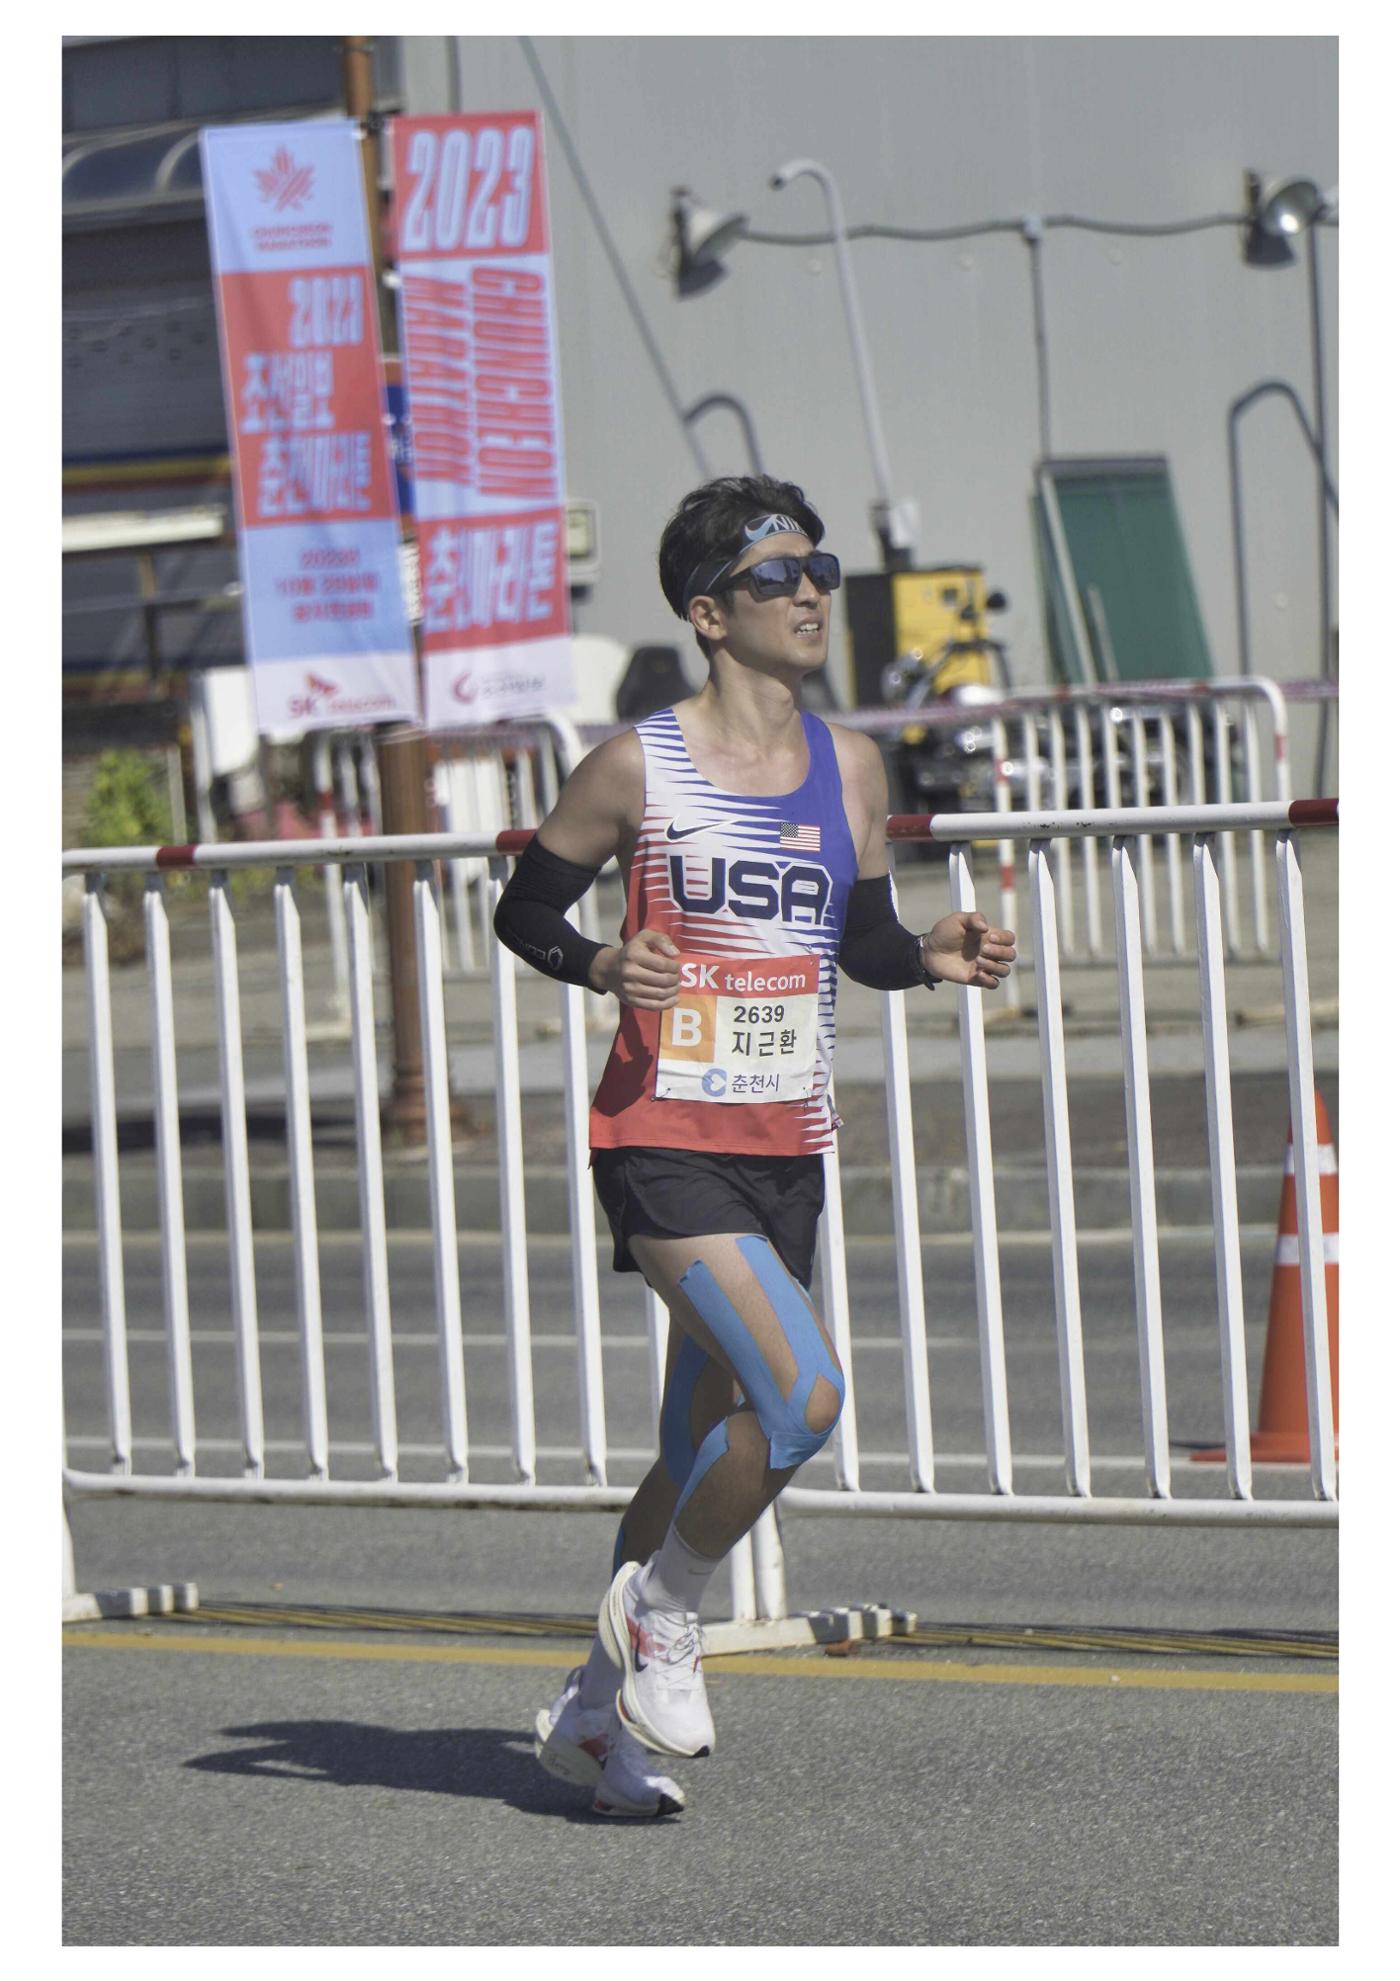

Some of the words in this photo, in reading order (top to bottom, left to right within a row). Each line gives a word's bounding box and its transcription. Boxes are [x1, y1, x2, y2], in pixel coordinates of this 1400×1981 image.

[403, 127, 533, 250] 2023
[402, 275, 472, 485] MARATHON
[471, 267, 557, 497] CHUNCHEON
[668, 854, 833, 926] USA
[680, 962, 719, 990] SK
[724, 971, 807, 993] telecom
[671, 1008, 703, 1047] B
[733, 1005, 785, 1024] 2639
[731, 1029, 798, 1057] 지근환
[731, 1074, 783, 1094] 춘천시
